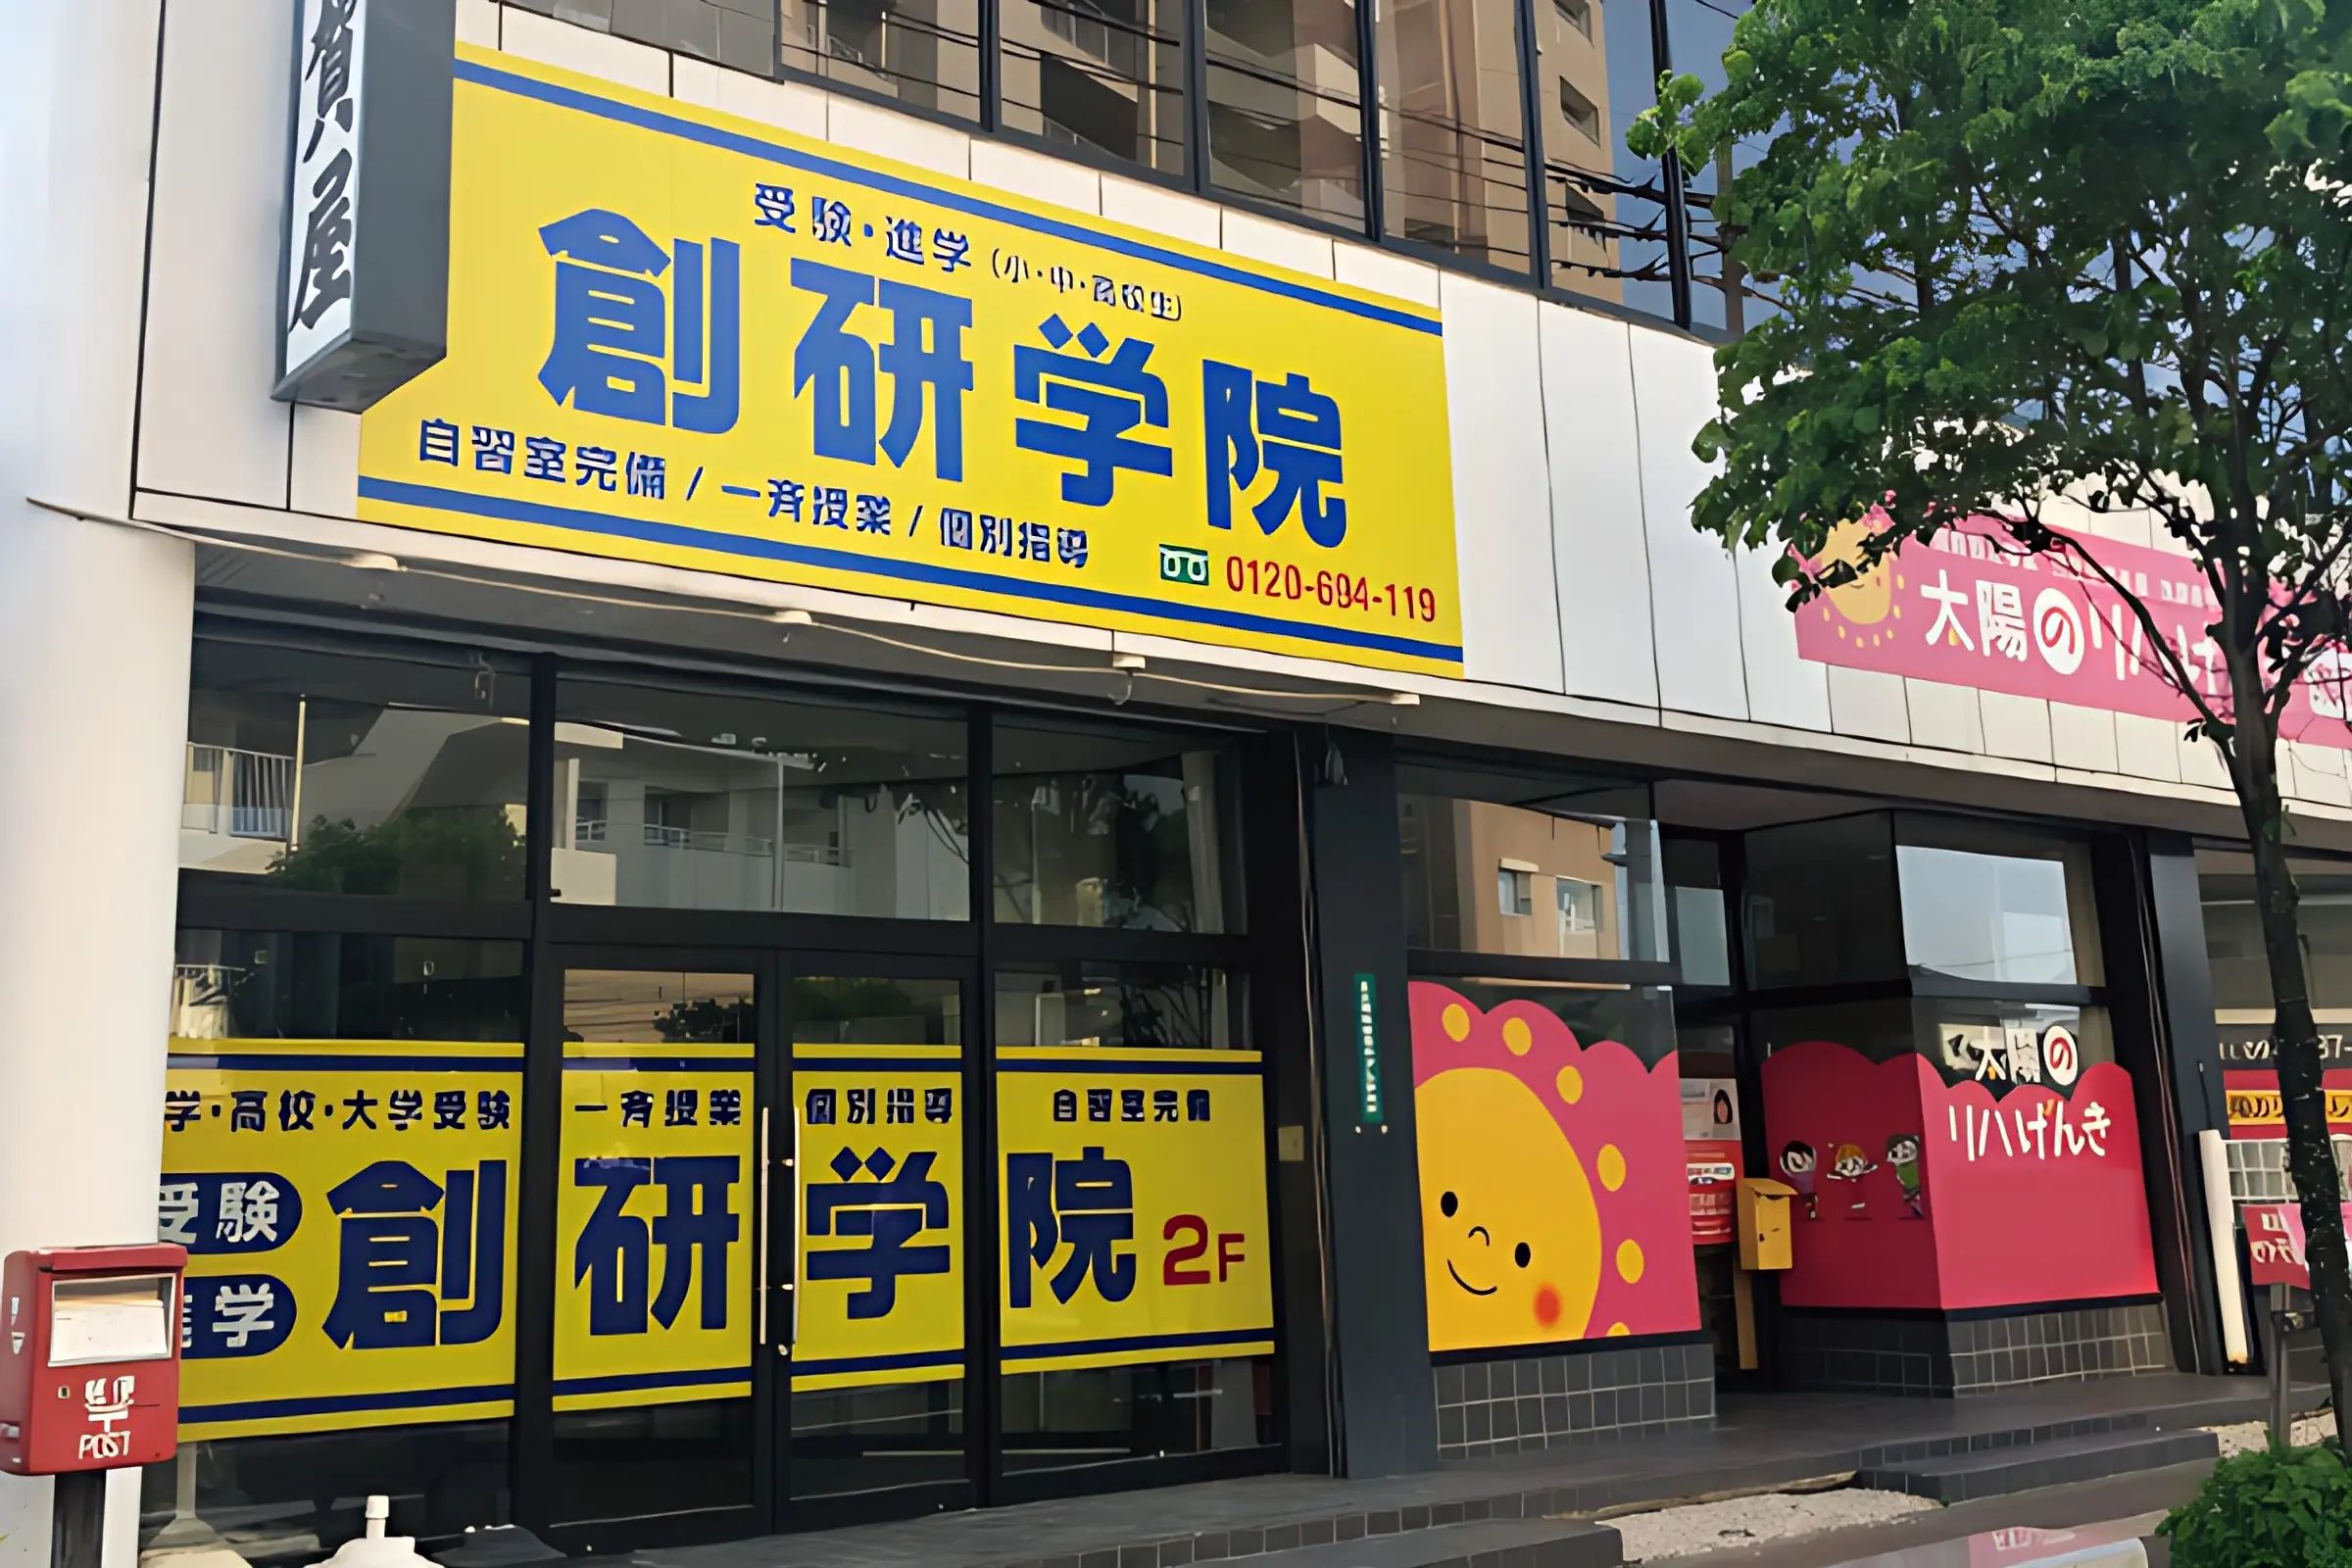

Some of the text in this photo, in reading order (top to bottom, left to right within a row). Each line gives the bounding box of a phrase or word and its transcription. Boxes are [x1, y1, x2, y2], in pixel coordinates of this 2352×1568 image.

[538, 208, 1348, 549] 創研学院
[419, 417, 666, 501] 自習室完備
[1948, 1100, 2112, 1162] リハげんき
[159, 1180, 280, 1244] 受験
[1162, 1213, 1246, 1286] 2F
[180, 1283, 275, 1349] 学
